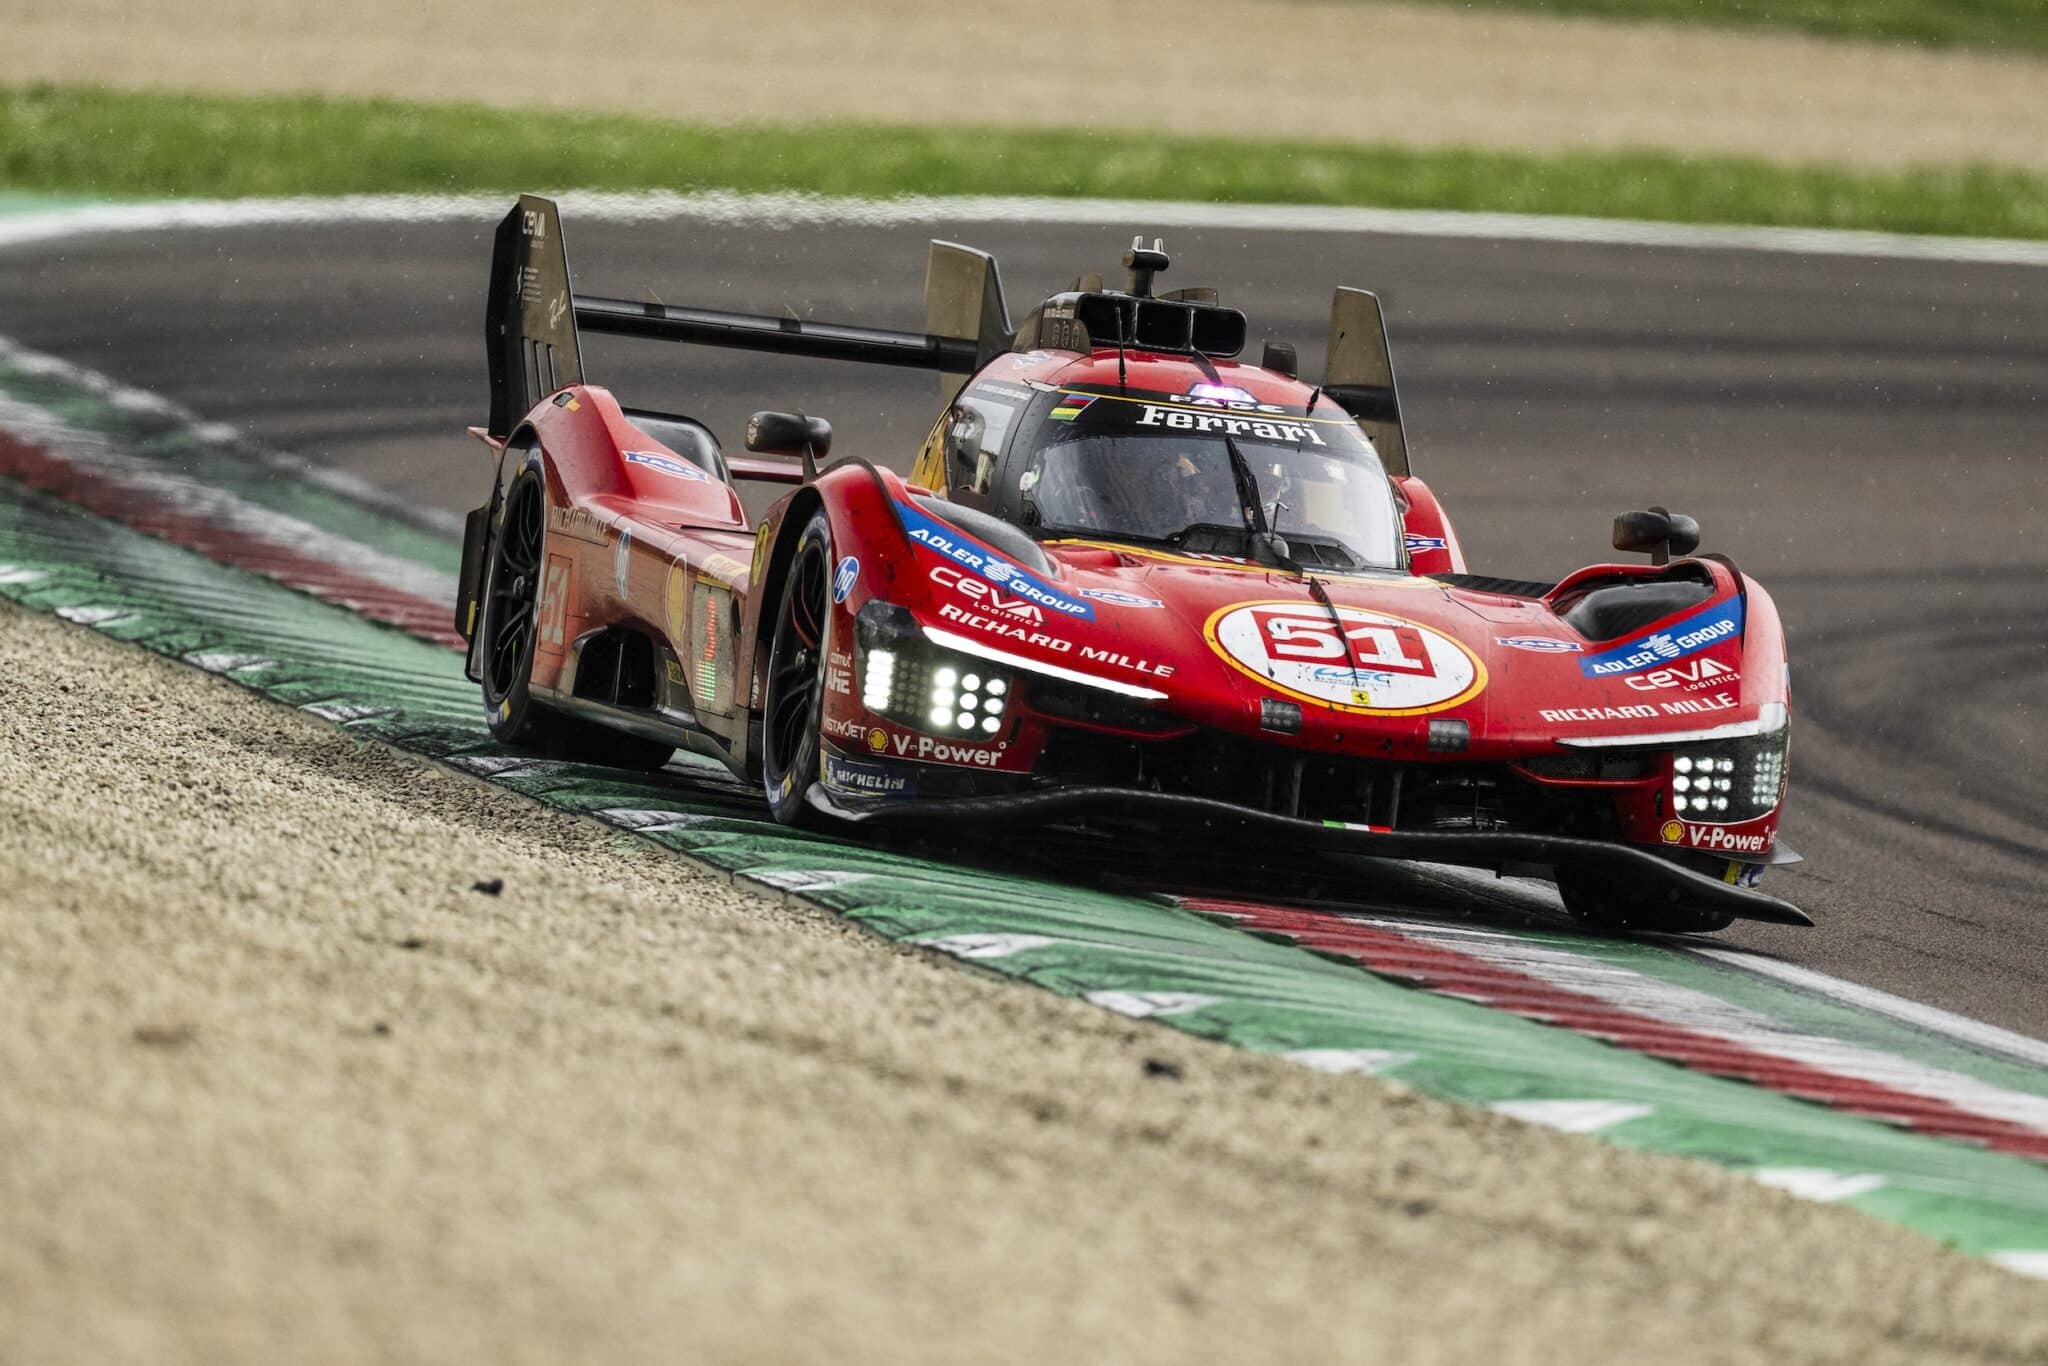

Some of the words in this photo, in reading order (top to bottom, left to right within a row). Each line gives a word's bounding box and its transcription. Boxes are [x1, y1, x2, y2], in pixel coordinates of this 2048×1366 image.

[1136, 404, 1327, 447] Ferrari
[909, 528, 983, 572] ADLER
[1009, 579, 1087, 615] GROUP
[973, 601, 1041, 627] LOGISTICS
[939, 604, 1072, 652] RICHARD
[1080, 645, 1176, 678] MILLE
[1267, 617, 1424, 670] 51
[1592, 652, 1657, 675] ADLER
[1676, 619, 1735, 649] GROUP
[1683, 672, 1741, 692] LOGISTICS
[1538, 703, 1659, 722] RICHARD
[1660, 692, 1738, 714] MILLE
[892, 733, 1003, 767] V-Power
[1689, 825, 1765, 851] V-Power
